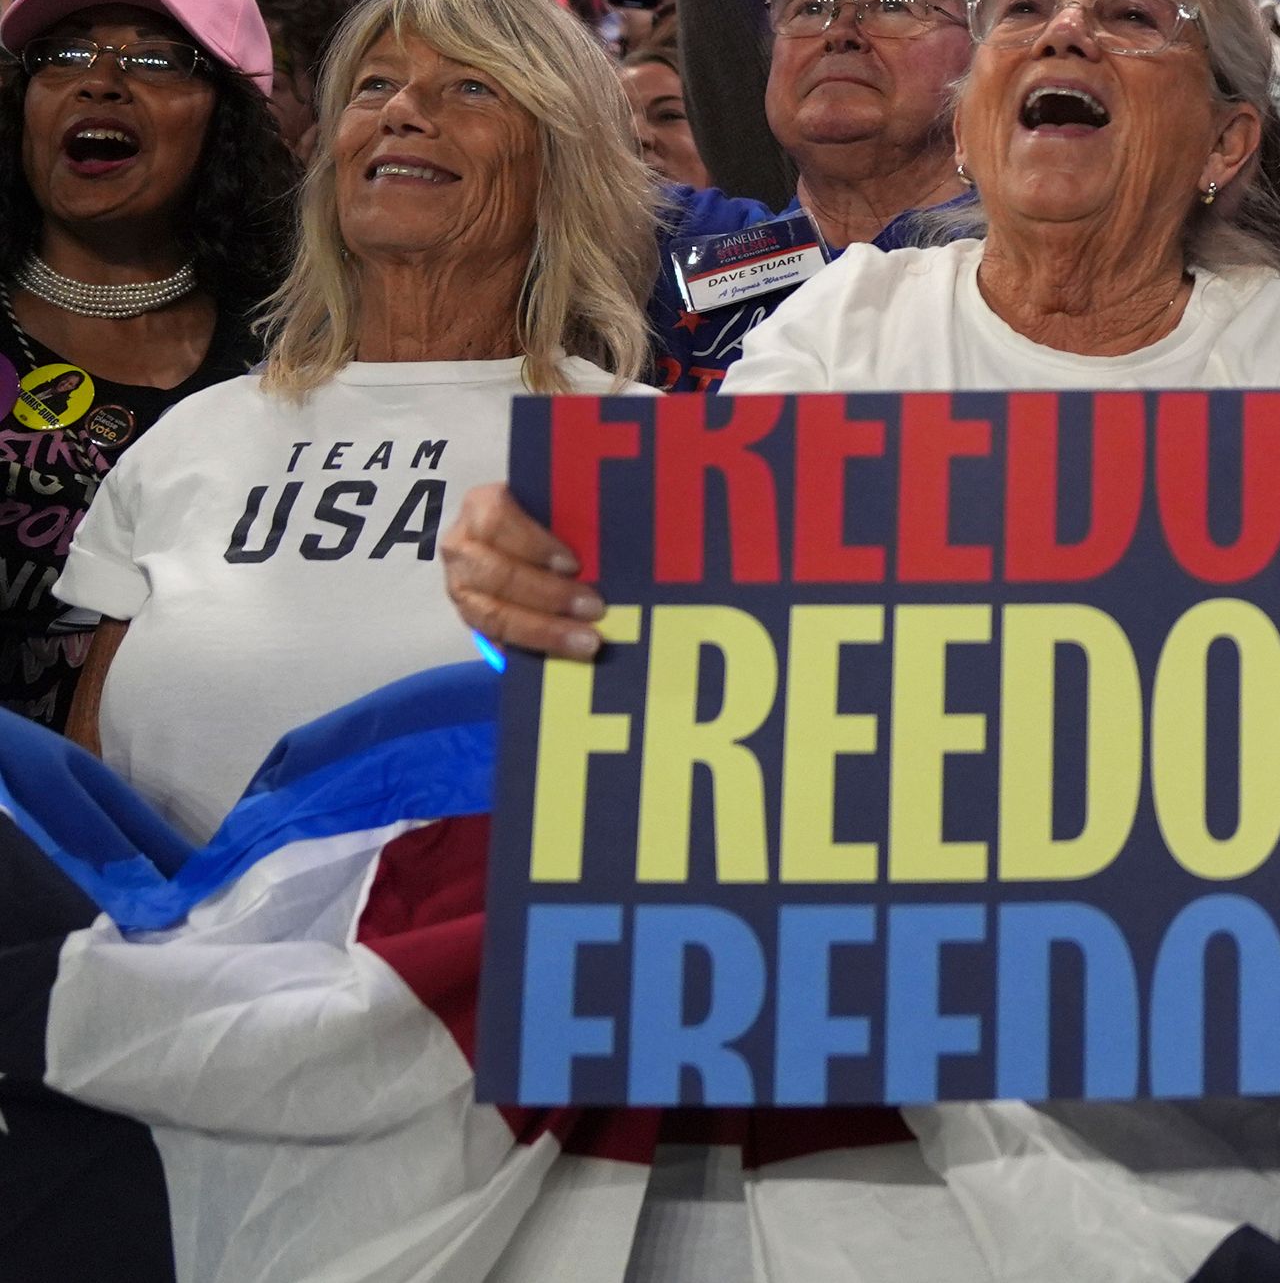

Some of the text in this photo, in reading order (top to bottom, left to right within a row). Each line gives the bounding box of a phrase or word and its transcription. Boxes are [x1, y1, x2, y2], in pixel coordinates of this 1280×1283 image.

[721, 229, 767, 251] JANELLE
[708, 253, 805, 289] DAVE STUART
[287, 439, 448, 473] TEAM
[223, 478, 447, 564] USA
